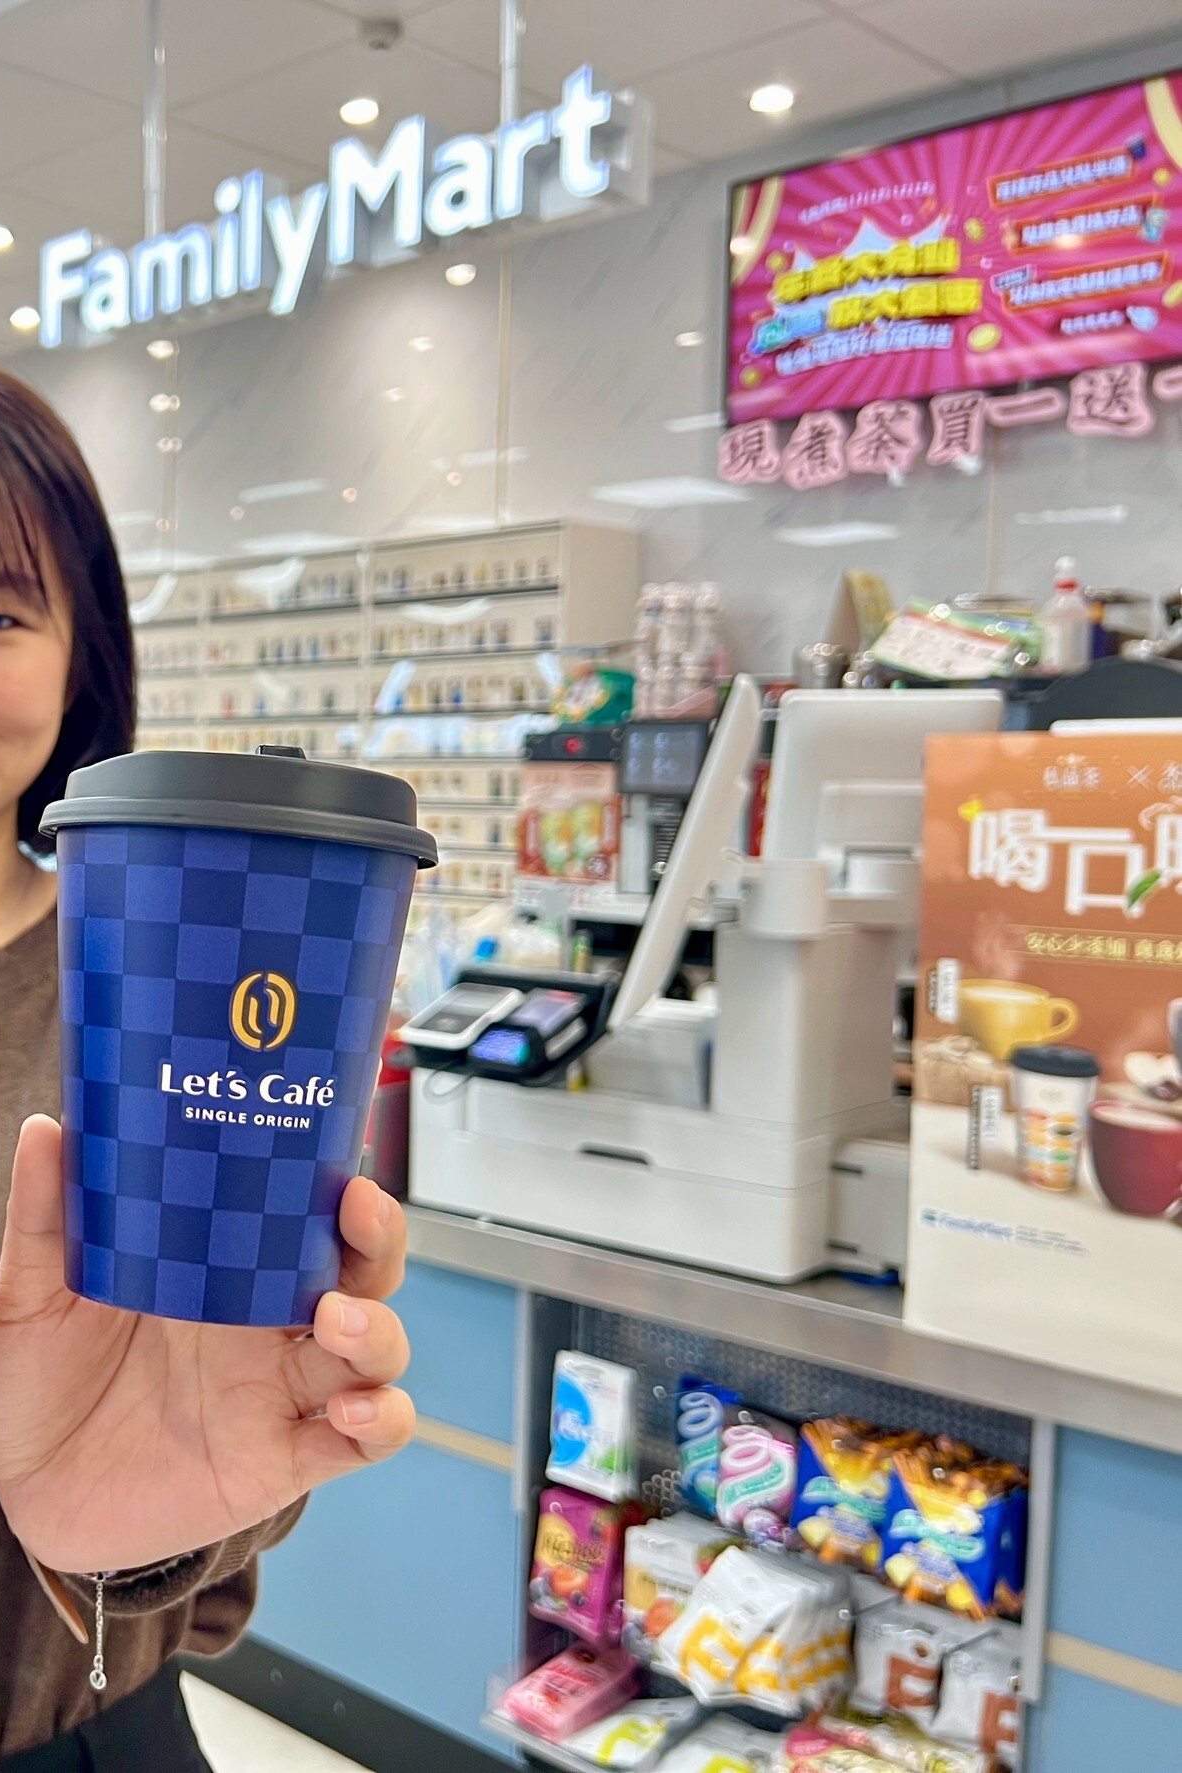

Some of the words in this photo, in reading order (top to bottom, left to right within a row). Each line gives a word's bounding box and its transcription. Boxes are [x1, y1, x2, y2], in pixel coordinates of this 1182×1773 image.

[39, 63, 614, 349] FamilyMart
[161, 1063, 248, 1100] Let's
[259, 1074, 335, 1107] Café
[185, 1106, 248, 1125] SINGLE
[253, 1113, 311, 1130] ORIGIN
